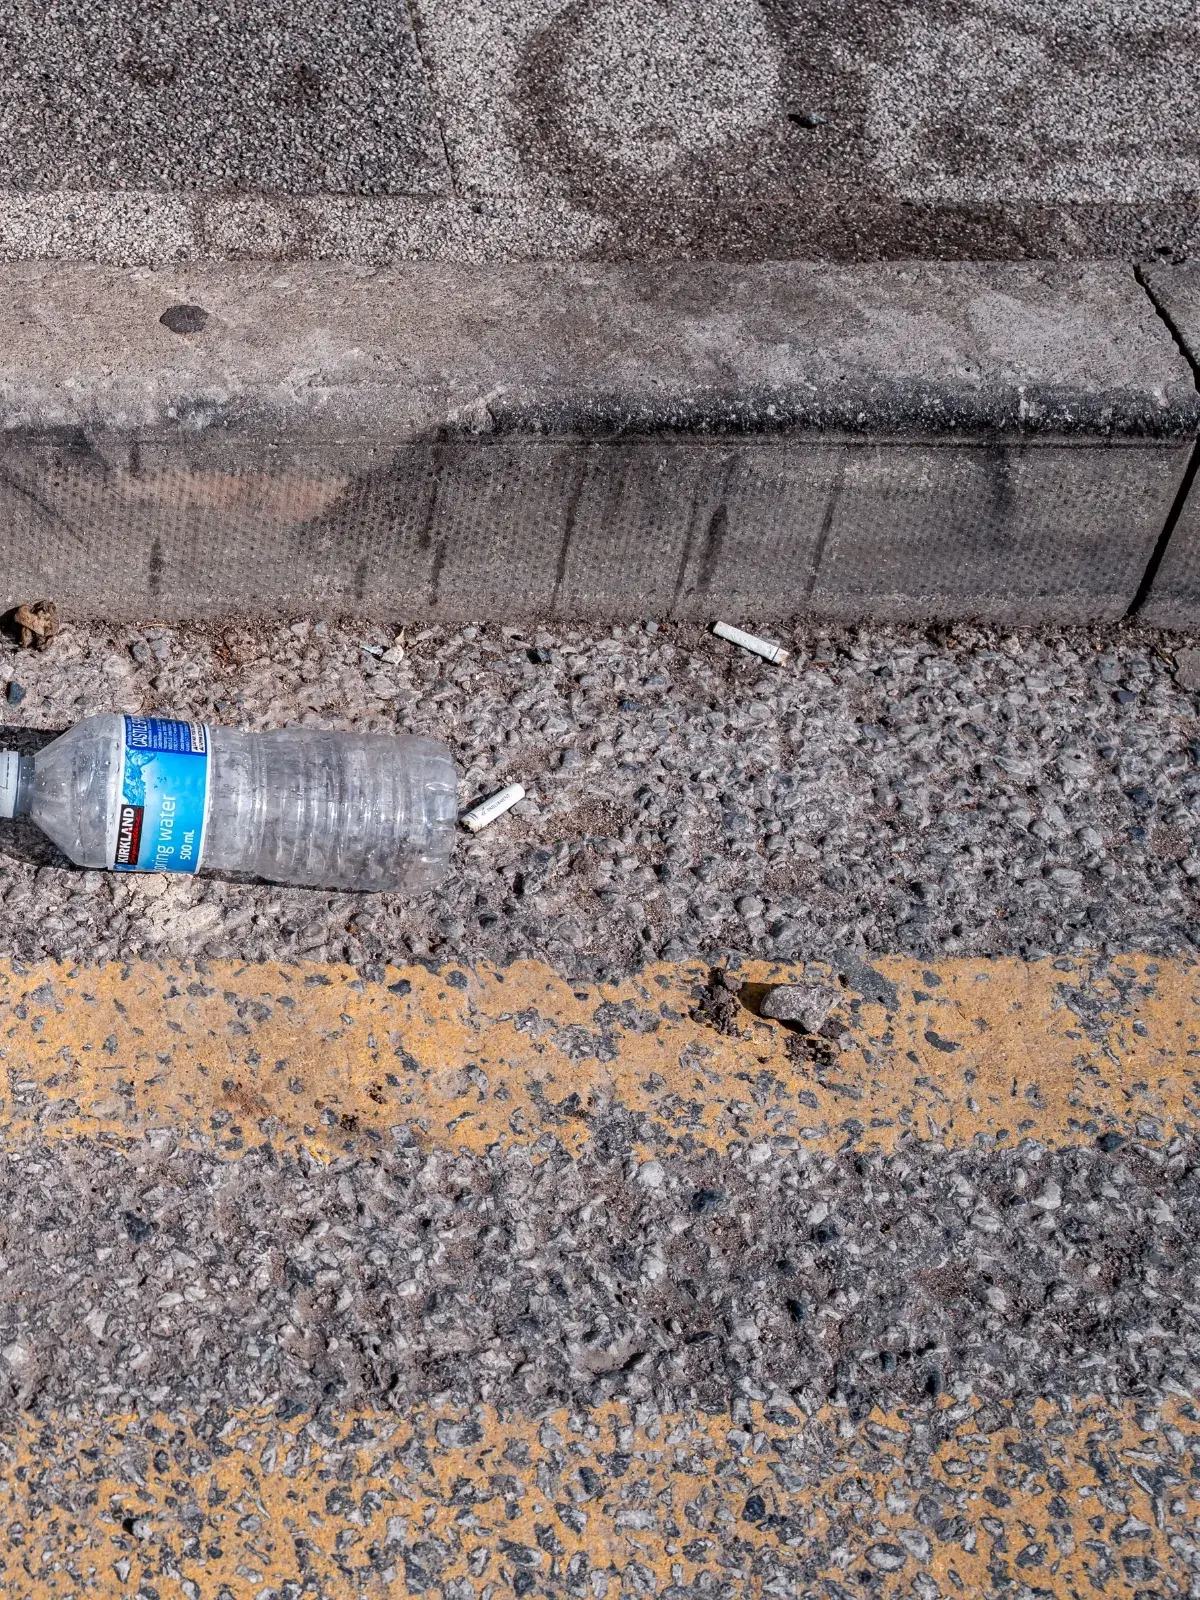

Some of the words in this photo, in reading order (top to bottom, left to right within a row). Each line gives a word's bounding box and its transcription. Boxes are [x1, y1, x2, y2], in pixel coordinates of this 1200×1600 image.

[132, 723, 148, 747] CASTLE
[158, 795, 176, 841] water
[117, 807, 135, 863] KIRKLAND
[183, 829, 195, 844] mL
[180, 844, 192, 860] 500
